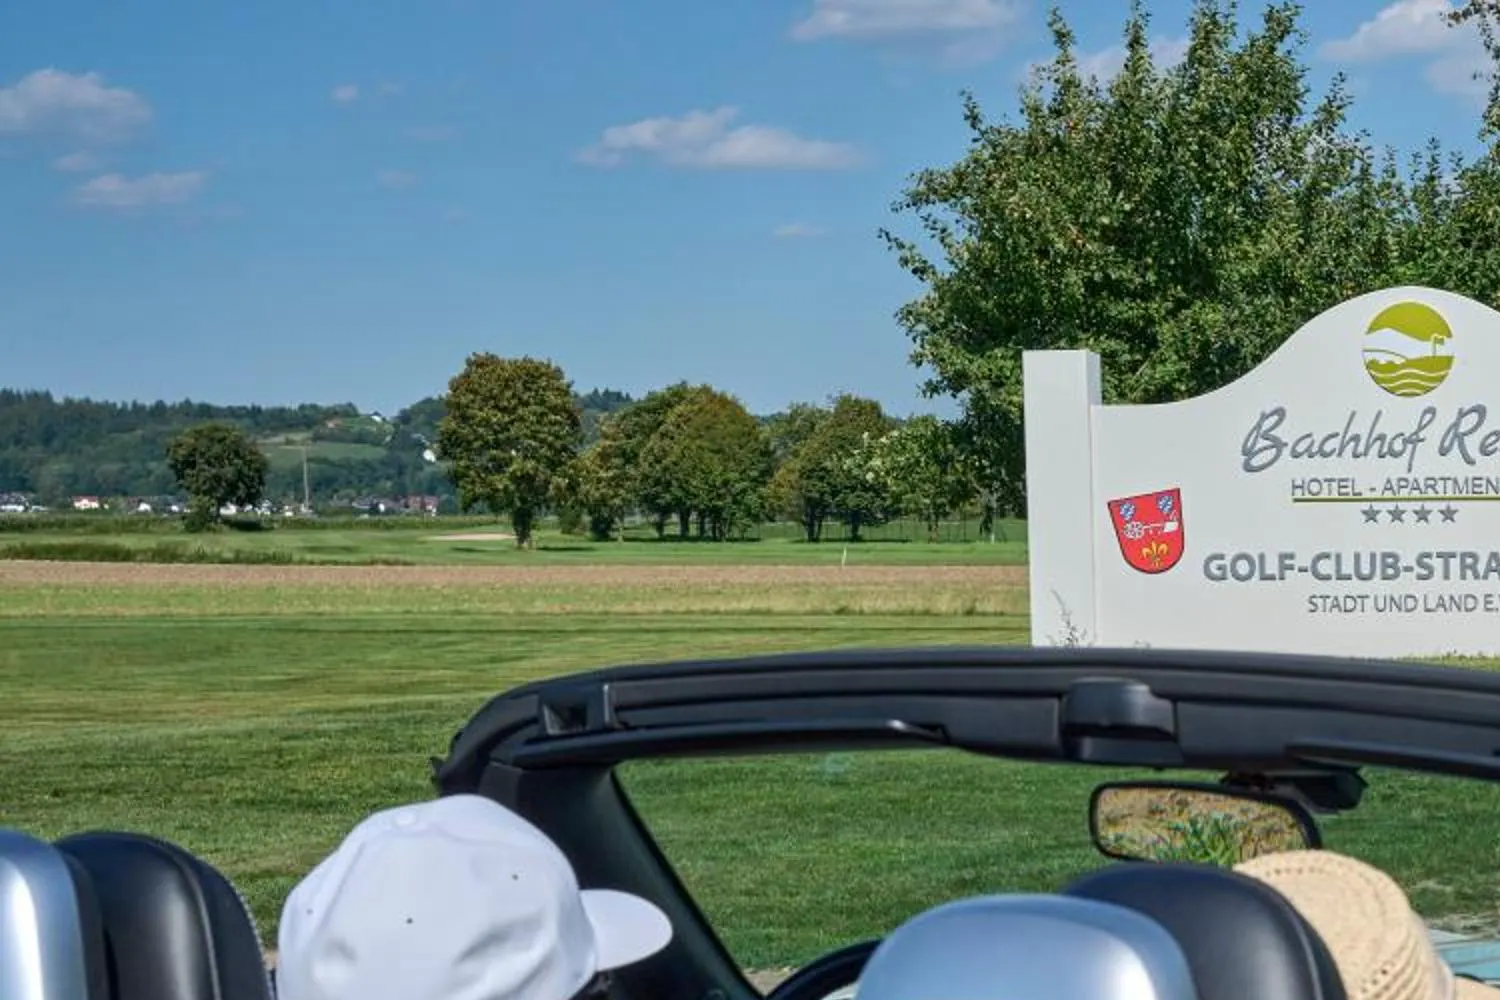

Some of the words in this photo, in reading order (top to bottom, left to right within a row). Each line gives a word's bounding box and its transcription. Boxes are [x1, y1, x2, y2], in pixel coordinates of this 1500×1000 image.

[1241, 406, 1437, 473] Bachhof
[1291, 478, 1363, 497] HOTEL
[1307, 594, 1369, 614] STADT
[1374, 594, 1418, 613] UND
[1423, 593, 1479, 613] LAND
